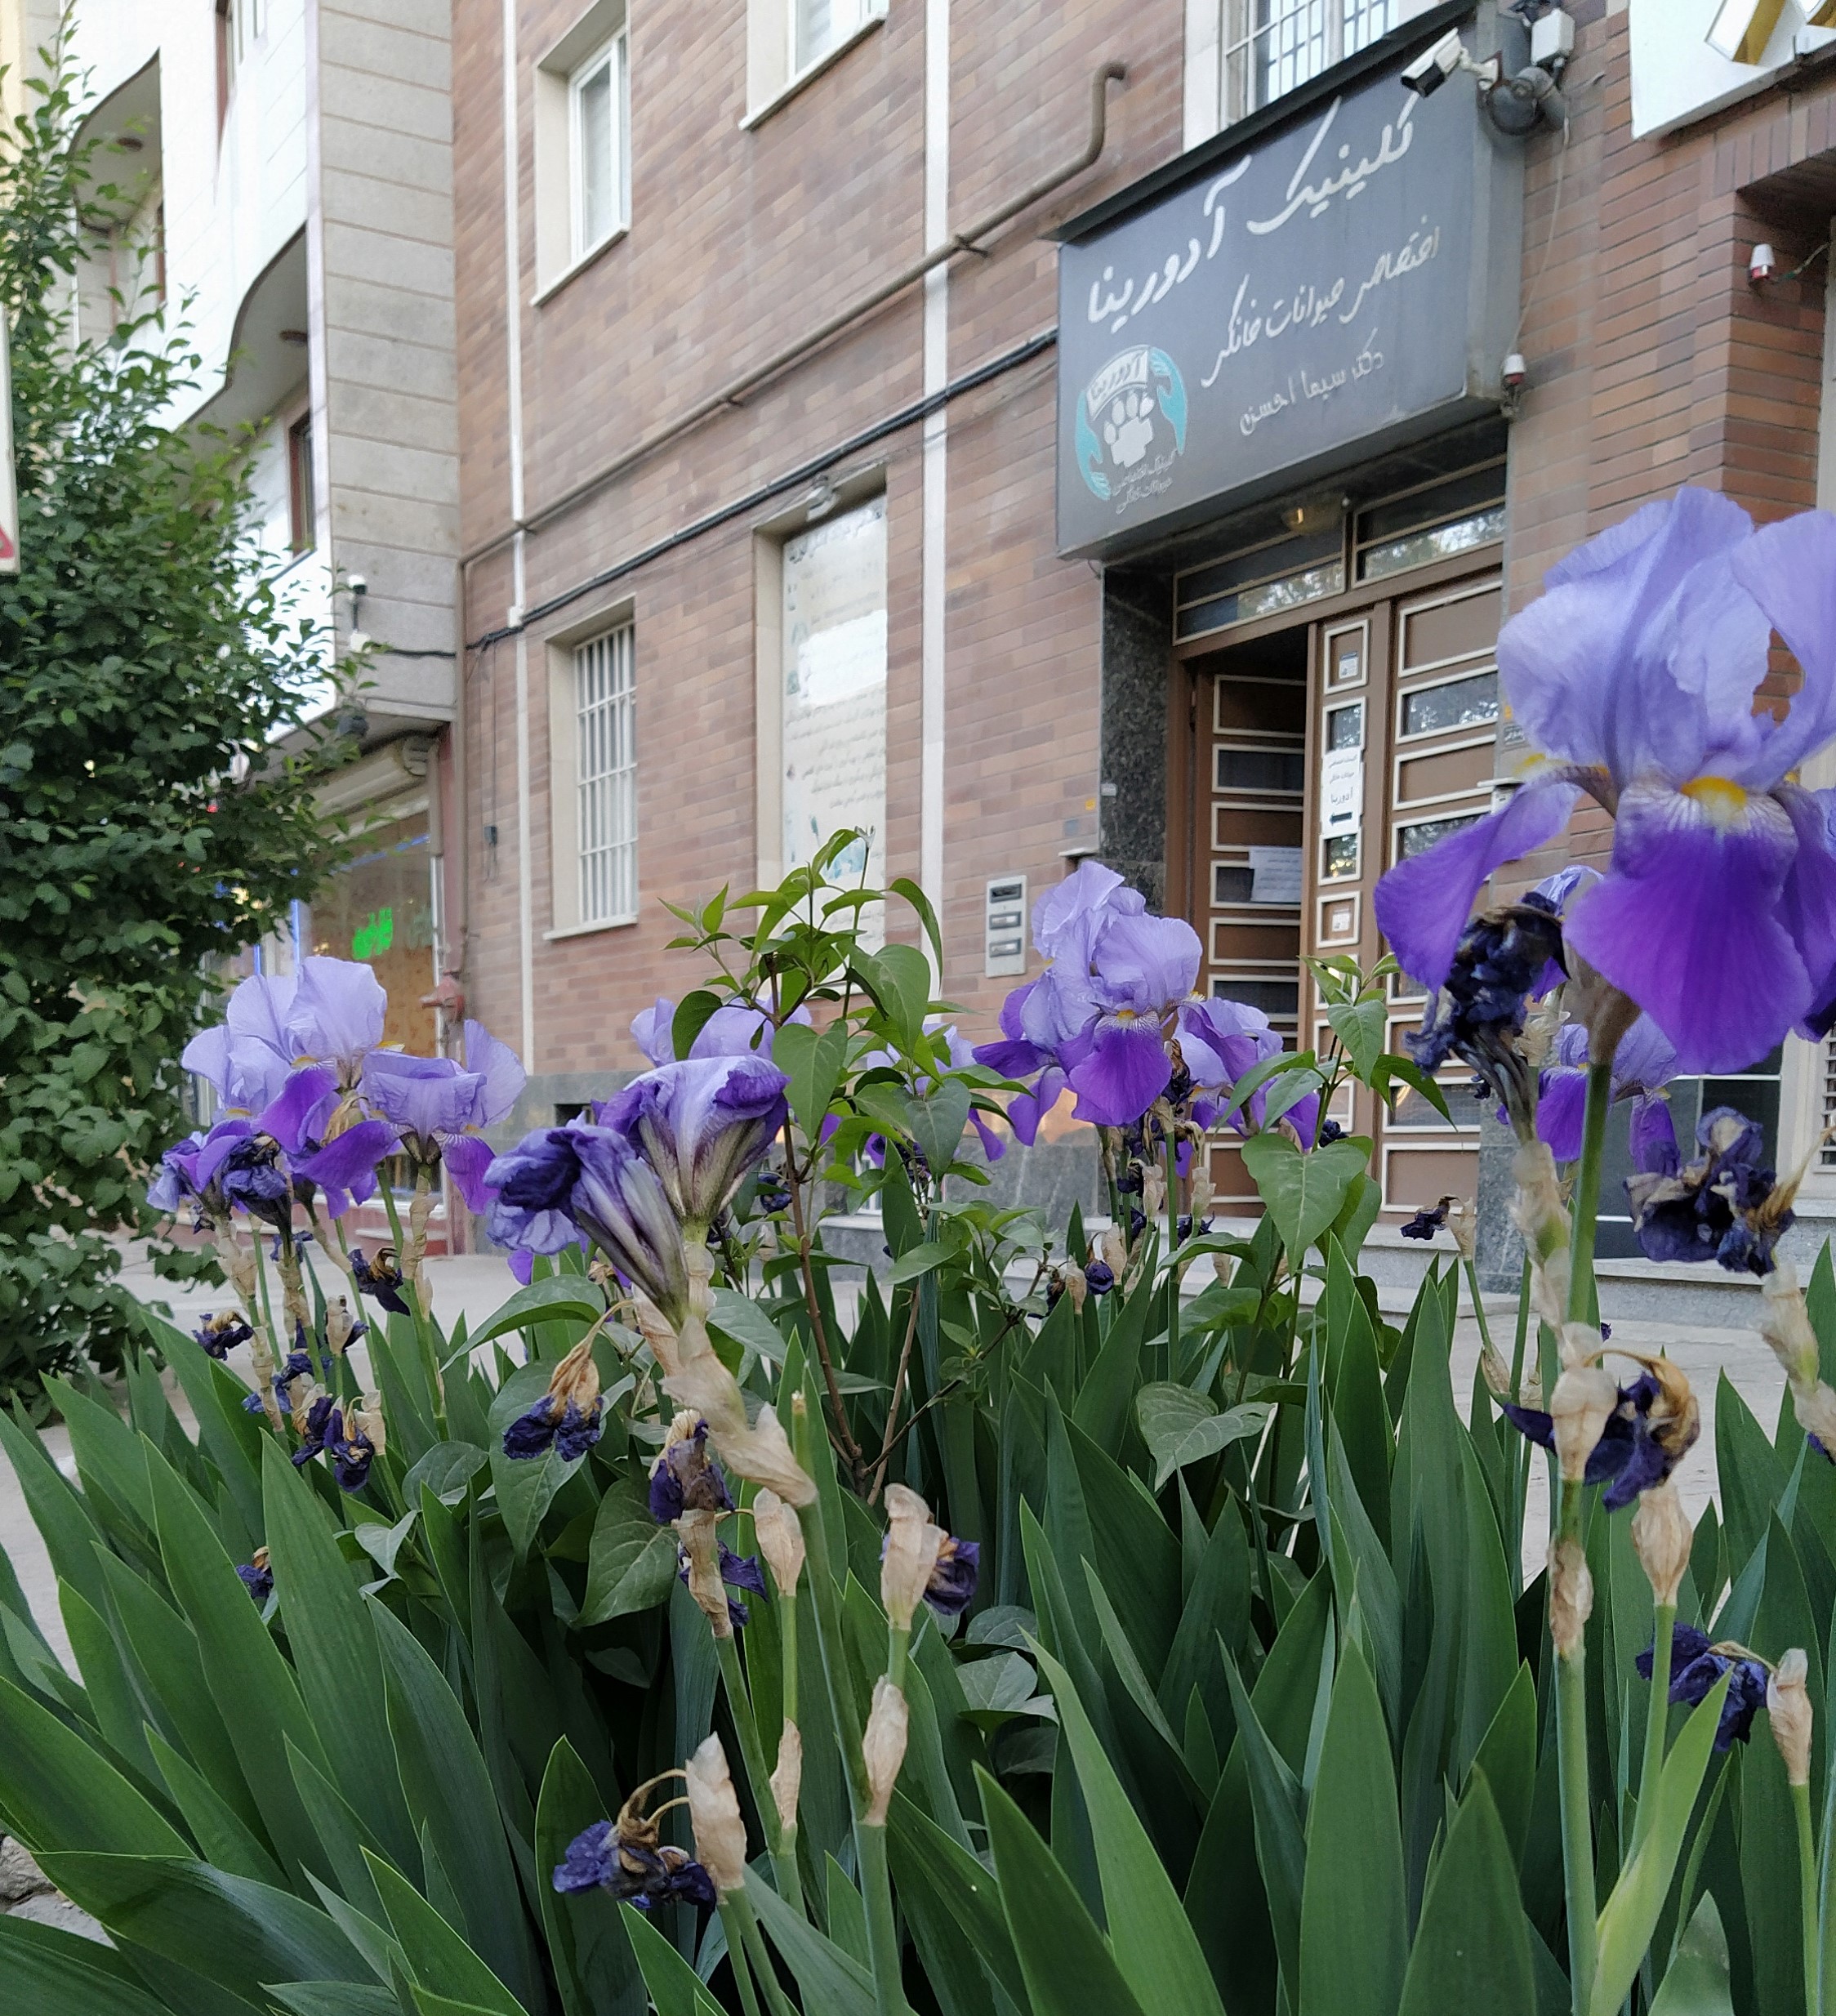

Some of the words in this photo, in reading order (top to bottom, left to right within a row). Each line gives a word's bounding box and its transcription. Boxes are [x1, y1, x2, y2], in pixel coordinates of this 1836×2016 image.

[1246, 91, 1420, 234] کلینیک
[1087, 154, 1253, 333] آدورینا
[1339, 213, 1440, 325] اختصاصی
[1201, 274, 1263, 389] خانگی
[1265, 276, 1345, 339] حیوانات
[1351, 327, 1385, 380] دکتر
[1299, 369, 1347, 400] سیما
